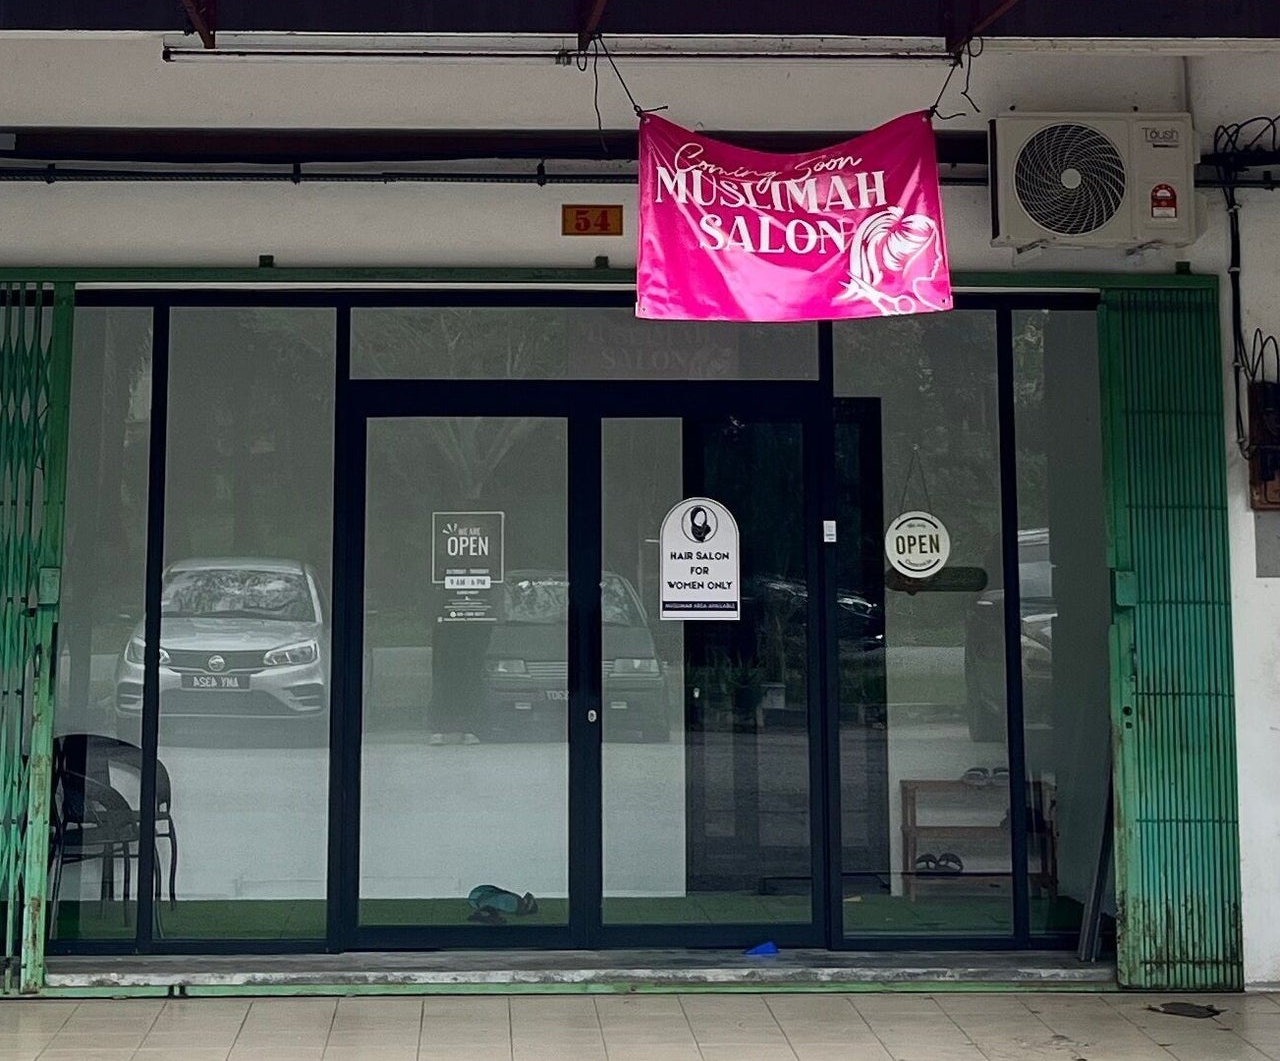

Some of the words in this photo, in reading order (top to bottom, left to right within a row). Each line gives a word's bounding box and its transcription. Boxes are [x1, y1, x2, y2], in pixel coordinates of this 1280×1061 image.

[674, 142, 783, 194] Coming
[792, 154, 862, 183] Soon
[655, 166, 888, 214] MUSLIMAH
[575, 209, 611, 232] 54
[699, 213, 848, 254] SALON
[447, 536, 489, 556] OPEN
[895, 534, 940, 555] OPEN
[670, 551, 694, 560] HAIR
[696, 551, 730, 560] SALON
[690, 566, 709, 575] FOR
[667, 581, 704, 590] WOMEN
[707, 581, 733, 590] ONLY
